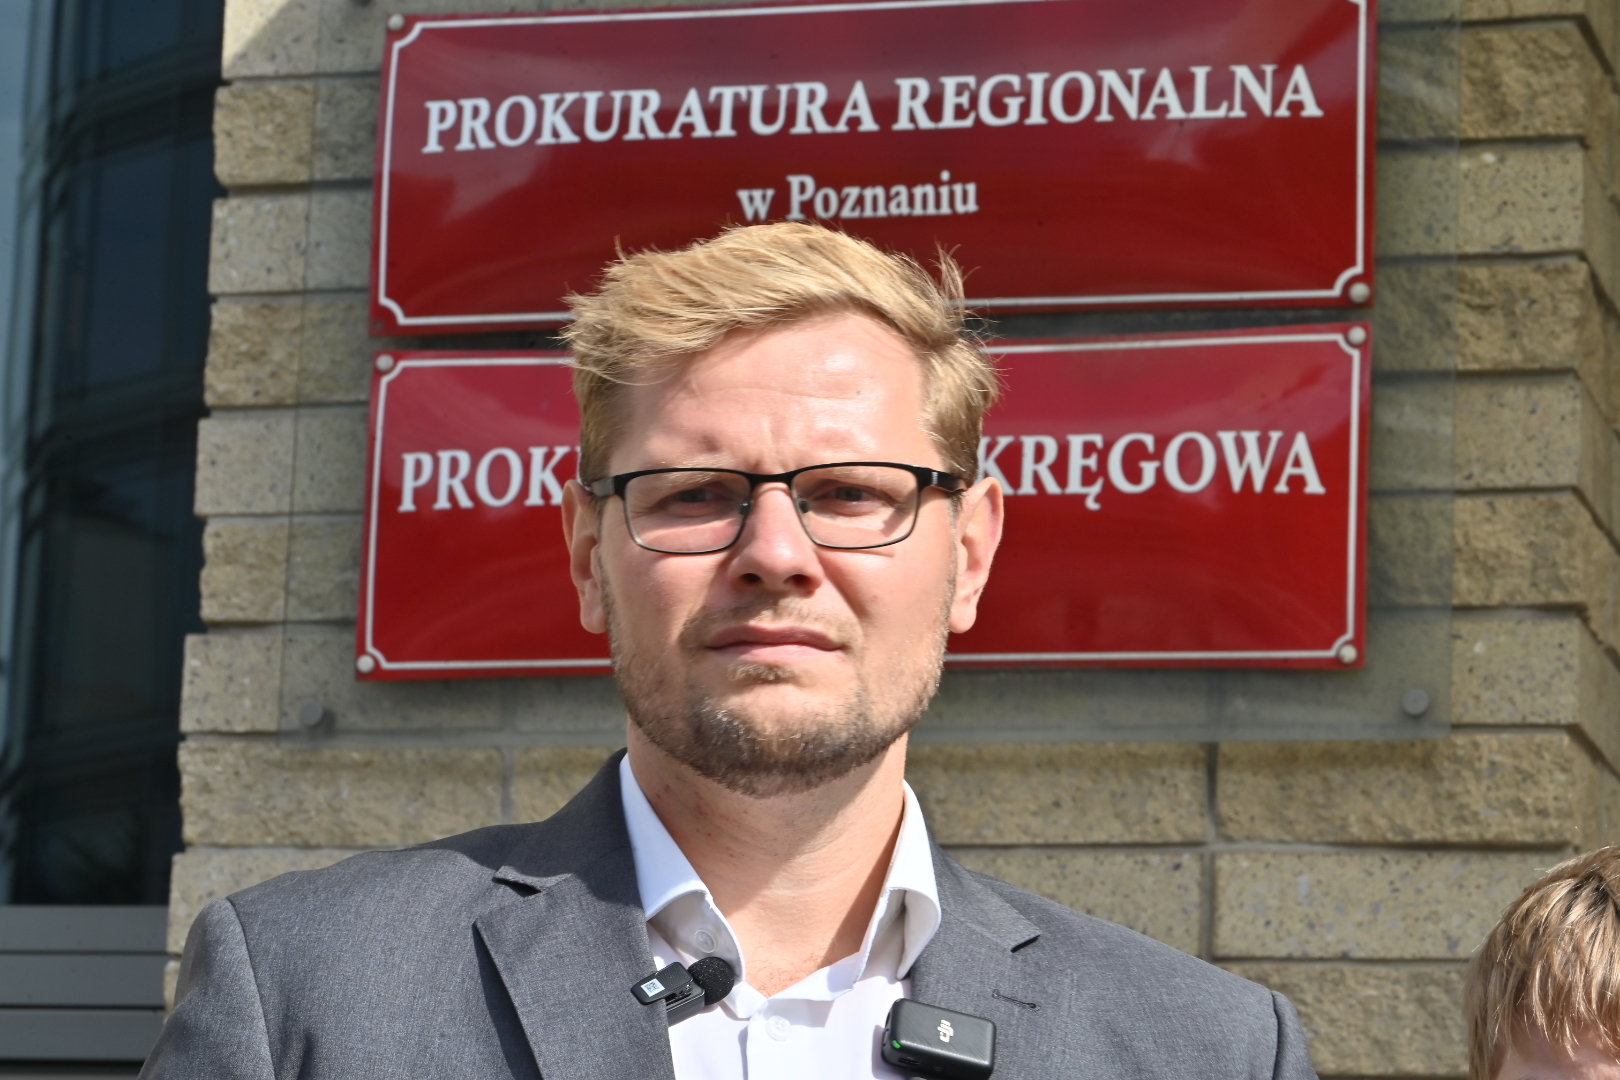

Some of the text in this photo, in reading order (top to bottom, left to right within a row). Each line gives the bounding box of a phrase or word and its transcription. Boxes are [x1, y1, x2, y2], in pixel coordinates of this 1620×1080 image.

[422, 64, 1324, 154] PROKURATURA REGIONALNA
[737, 170, 978, 221] w Poznaniu
[397, 430, 1326, 513] PROK KRĘGOWA
